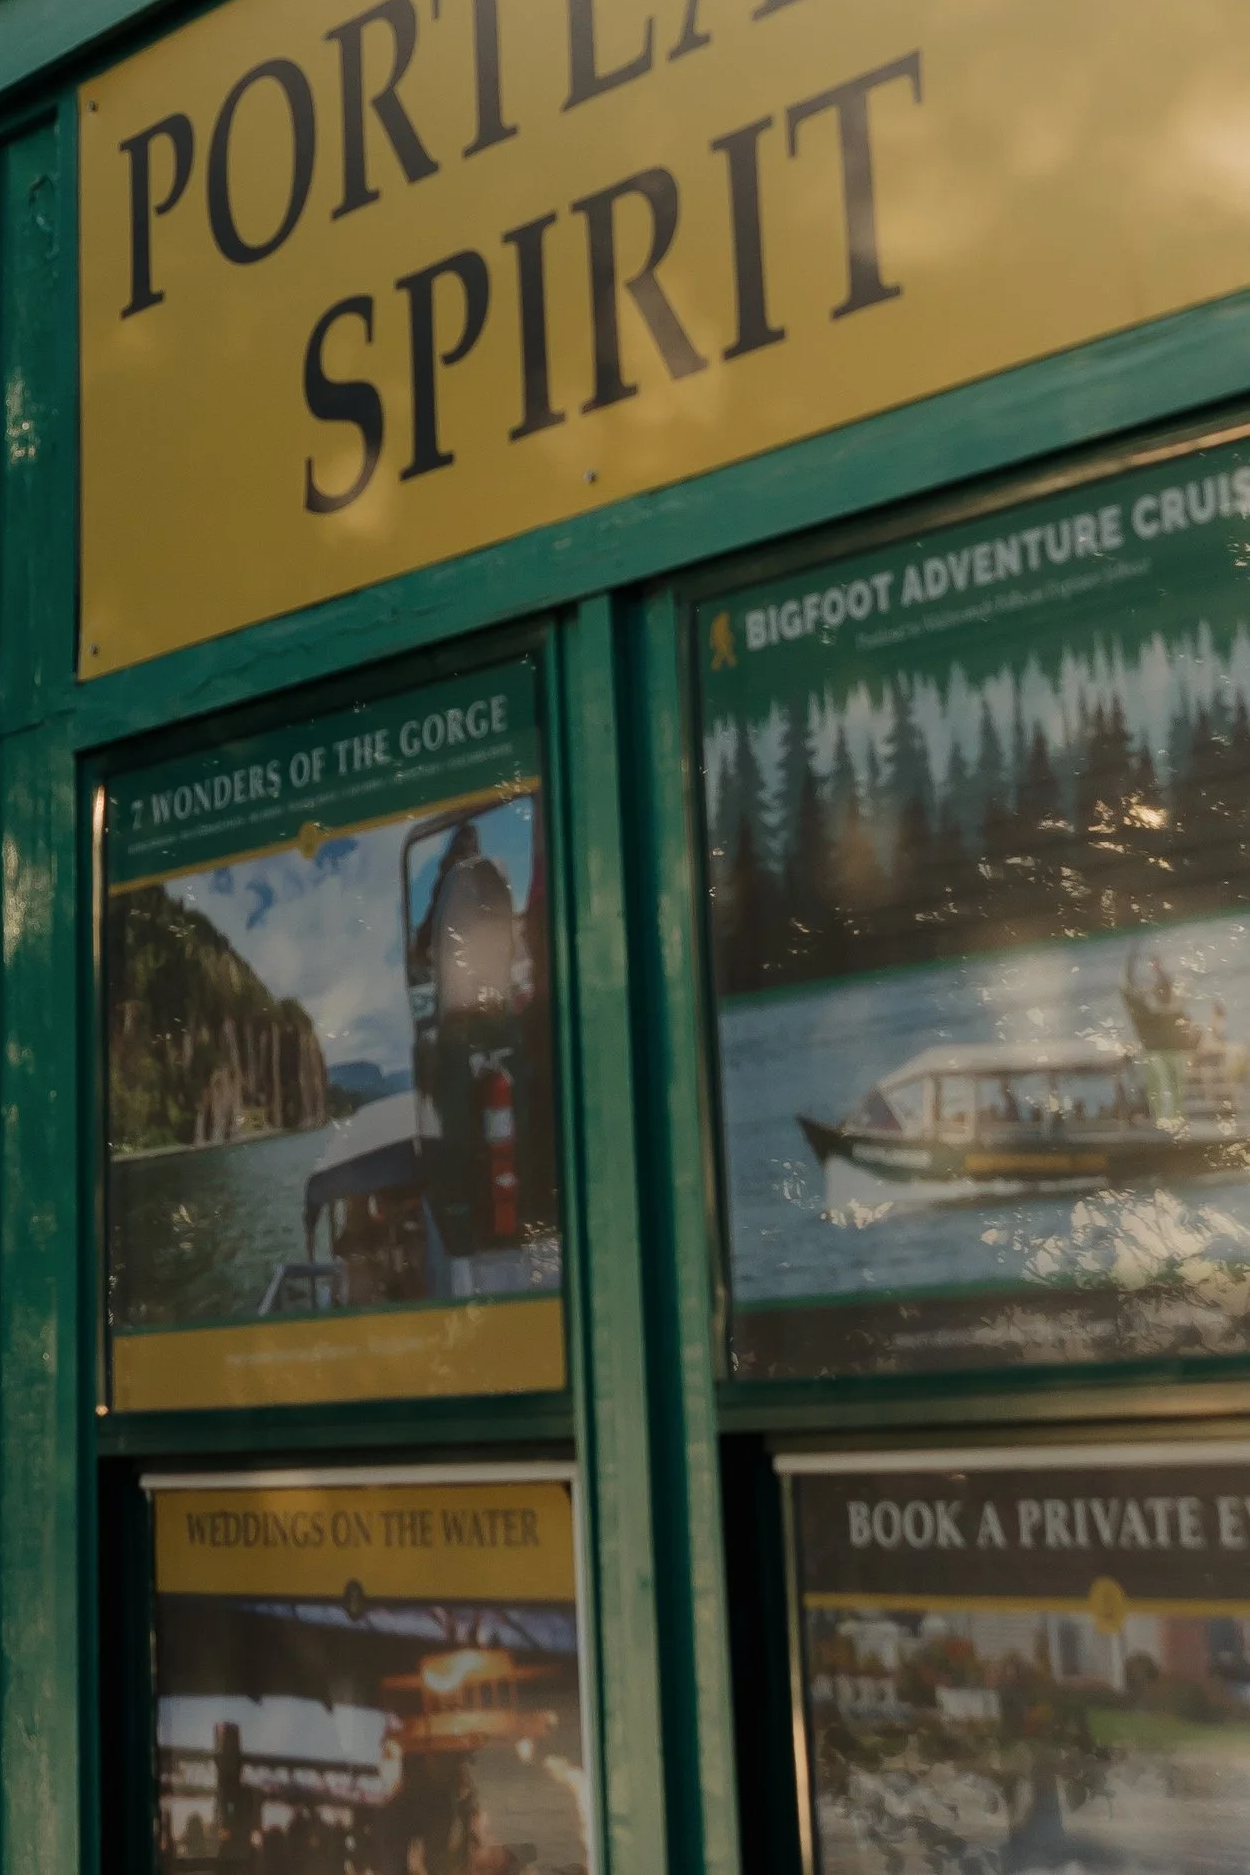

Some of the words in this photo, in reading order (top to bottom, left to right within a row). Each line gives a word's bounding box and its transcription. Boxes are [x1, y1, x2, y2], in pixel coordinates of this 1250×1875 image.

[302, 49, 926, 515] SPIRIT
[745, 571, 897, 651] BIGFOOT
[901, 504, 1126, 608] ADVENTURE
[151, 759, 282, 824] WONDERS
[289, 750, 325, 790] OF
[332, 728, 390, 776] THE
[399, 694, 509, 758] GORGE
[186, 1508, 326, 1549] WEDDINGS
[331, 1508, 373, 1549] ON
[381, 1508, 434, 1549] THE
[441, 1507, 540, 1548] WATER
[846, 1499, 965, 1550] BOOK
[975, 1499, 1007, 1550] A
[1016, 1496, 1205, 1550] PRIVATE
[1214, 1494, 1250, 1551] E
